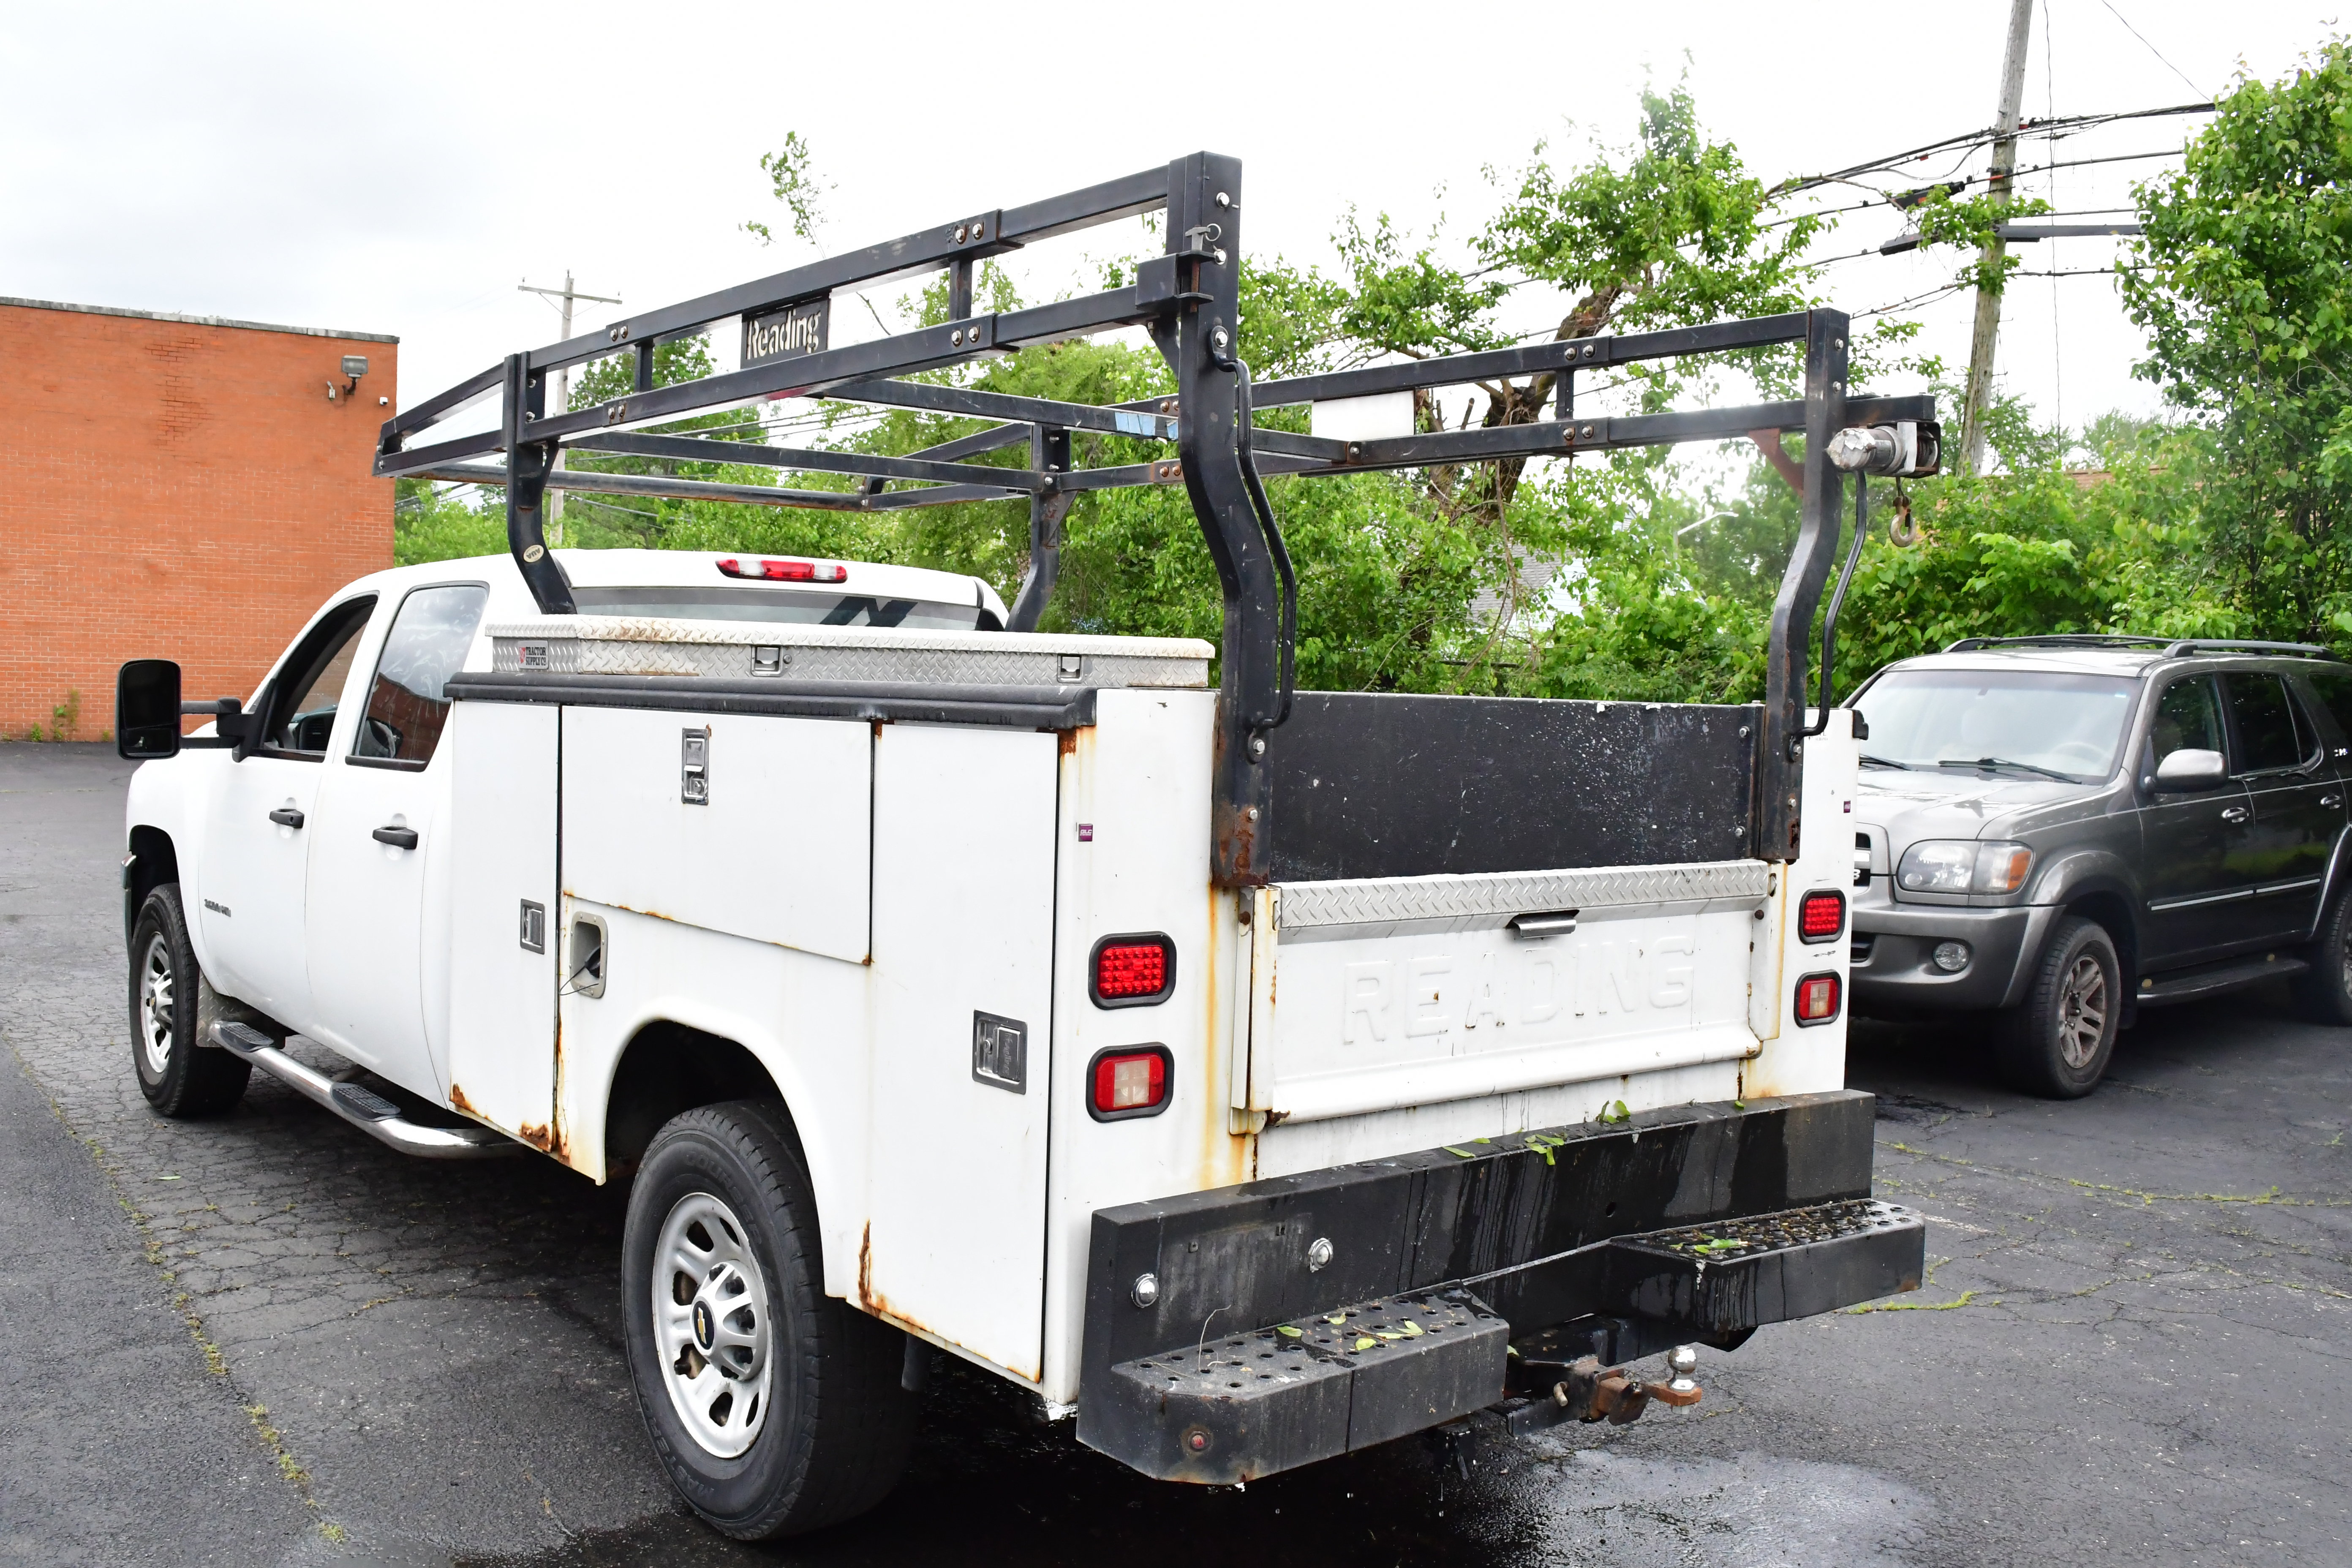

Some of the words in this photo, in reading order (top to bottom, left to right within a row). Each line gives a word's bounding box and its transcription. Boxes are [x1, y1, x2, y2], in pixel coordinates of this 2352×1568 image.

[746, 309, 821, 360] Reading
[525, 647, 546, 656] TRACTOR
[525, 657, 541, 666] SUPPLY
[1343, 936, 1694, 1045] READING
